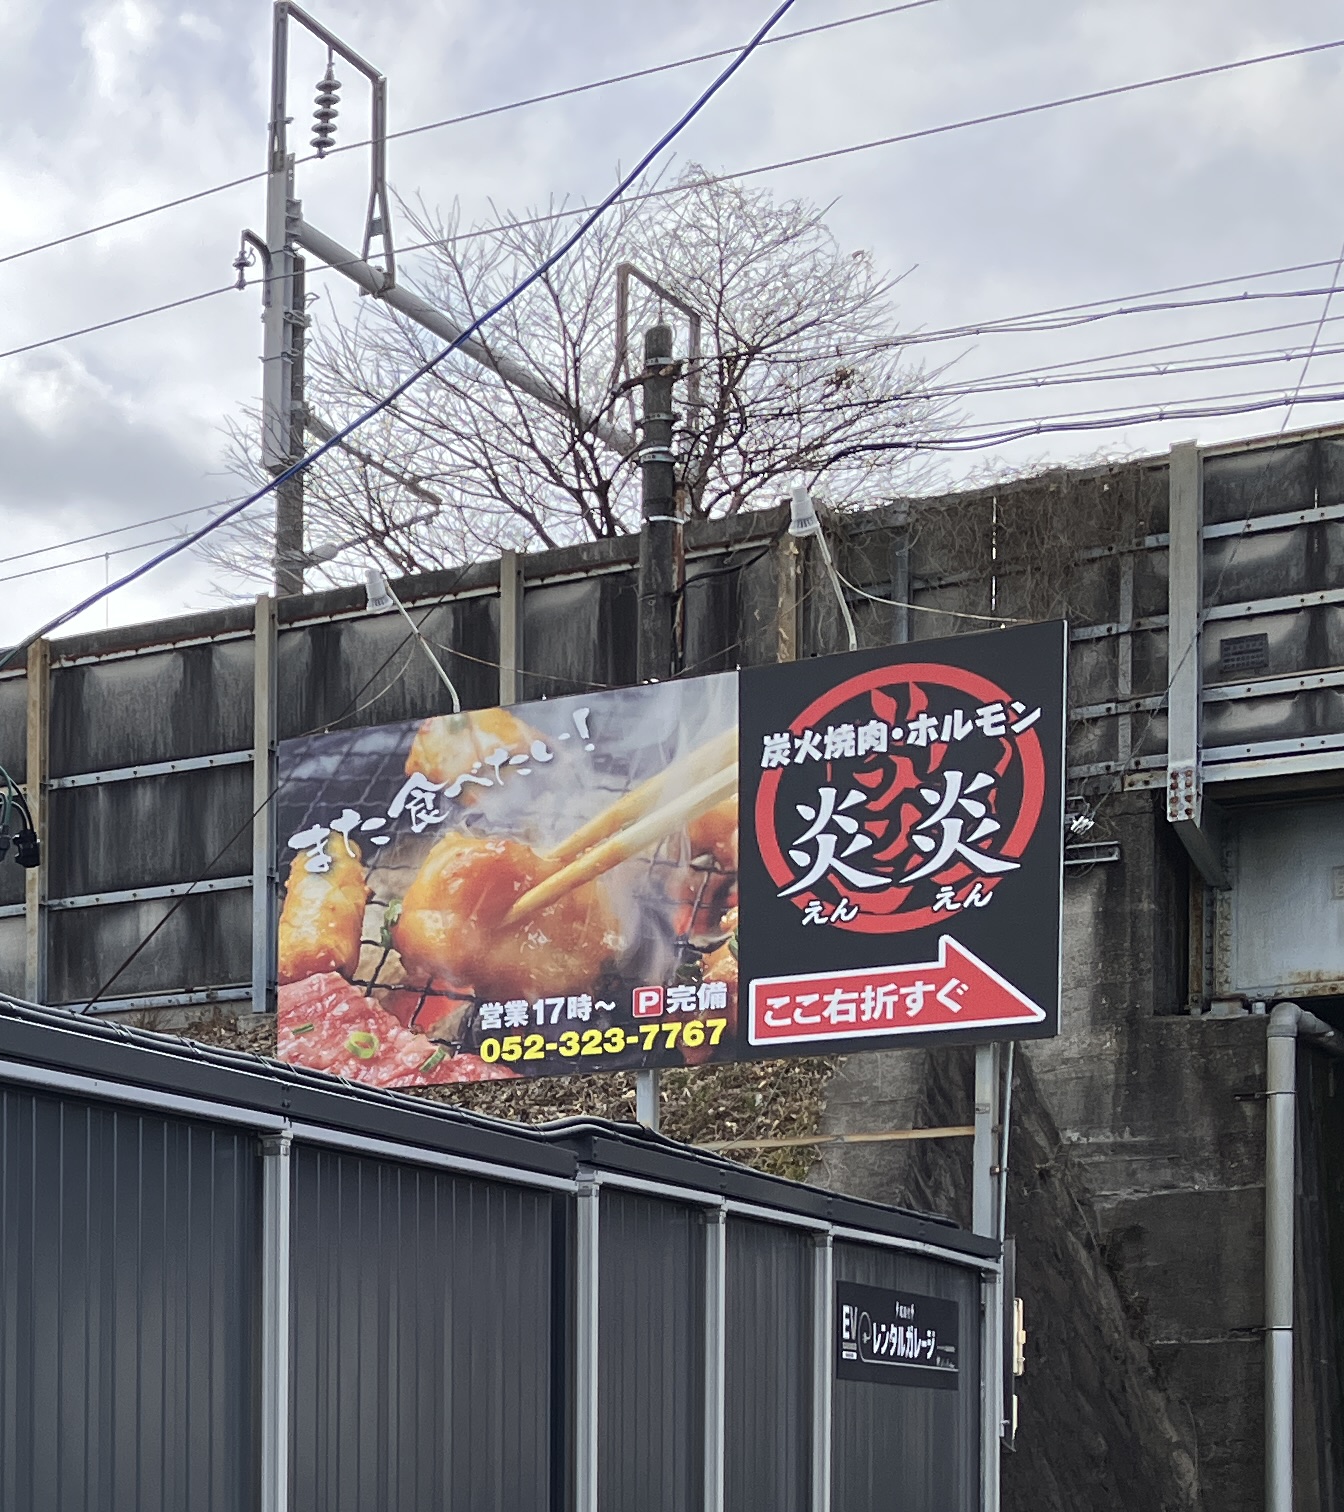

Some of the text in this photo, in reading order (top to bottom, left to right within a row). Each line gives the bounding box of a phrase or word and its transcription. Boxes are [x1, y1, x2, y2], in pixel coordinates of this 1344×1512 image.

[761, 701, 1041, 768] 炭火焼肉・ホルモン
[802, 897, 859, 926] えん
[932, 883, 993, 911] えん
[764, 977, 970, 1027] ここ右折すぐ
[479, 1018, 727, 1064] 052-323-7767
[842, 1304, 858, 1340] EV
[872, 1322, 936, 1360] レンタルガレージ
